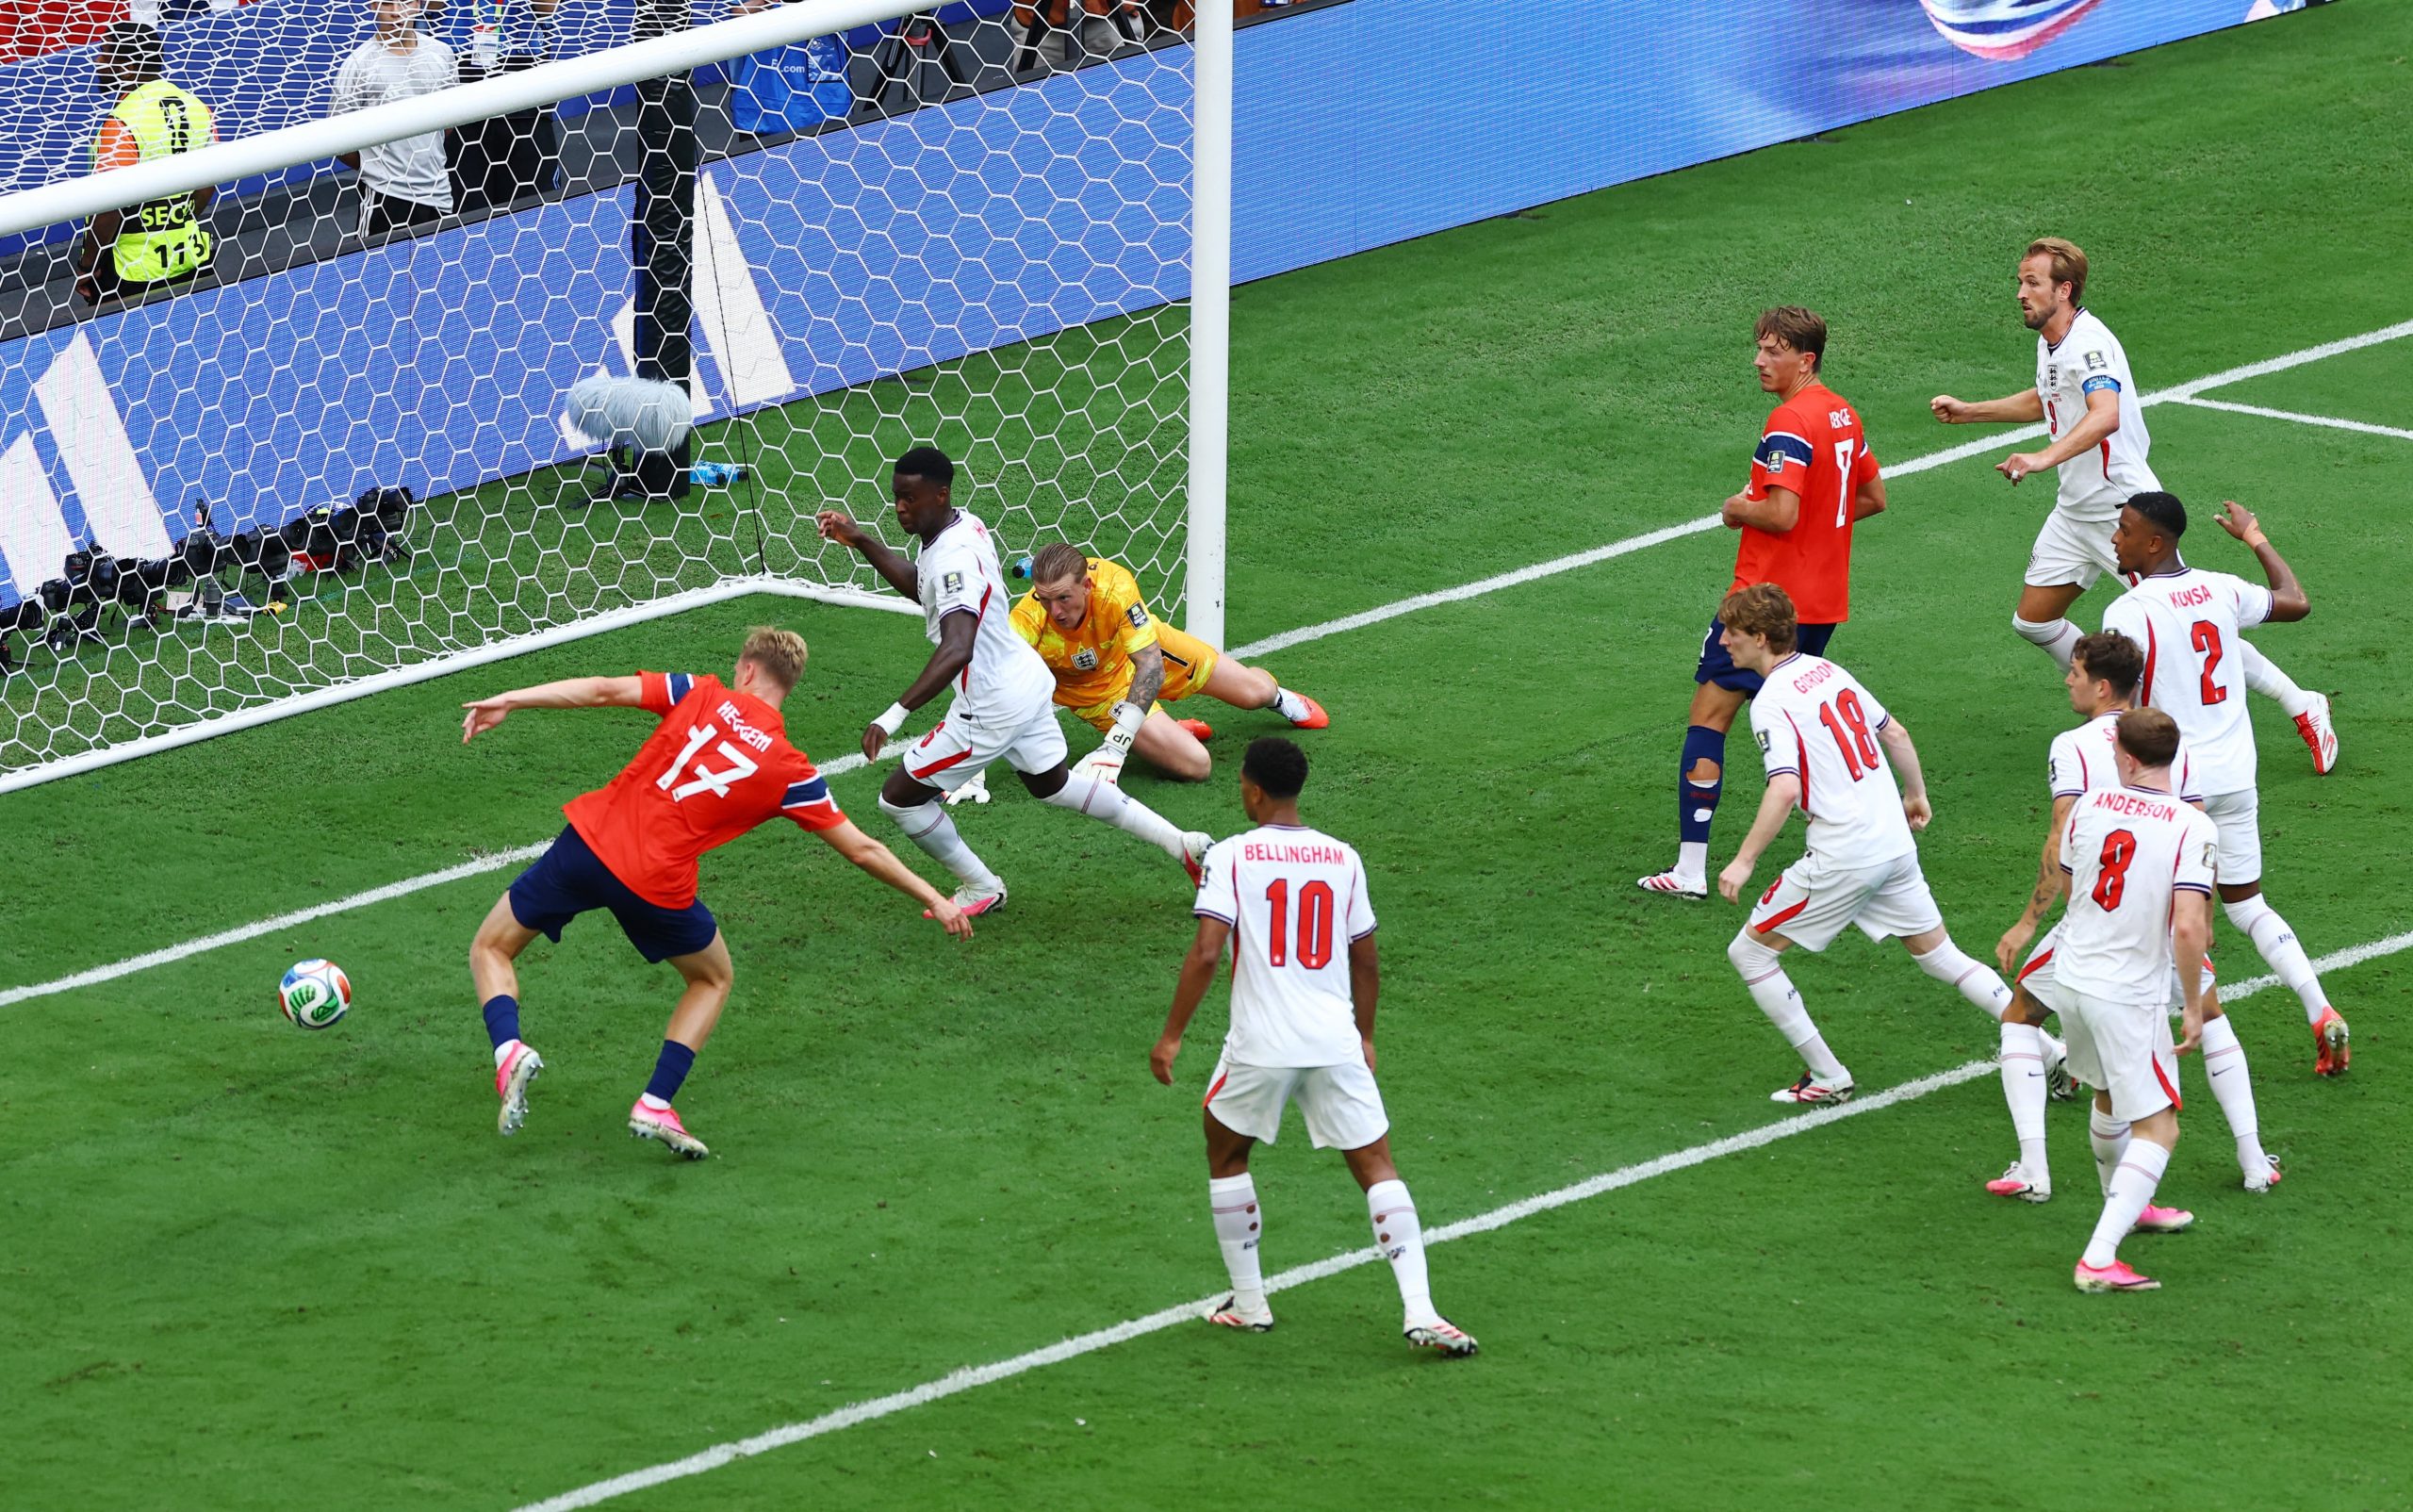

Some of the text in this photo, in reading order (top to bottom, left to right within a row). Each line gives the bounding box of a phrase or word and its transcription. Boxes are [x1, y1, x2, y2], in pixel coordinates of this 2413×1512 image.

[154, 233, 205, 269] 113
[2047, 400, 2058, 436] 9
[1793, 662, 1834, 695] GORDON
[2191, 618, 2226, 706] 2
[655, 722, 760, 803] 17
[1819, 687, 1880, 783] 18
[2093, 793, 2177, 823] ANDERSON
[1244, 844, 1345, 866] BELLINGHAM
[2092, 829, 2137, 912] 8
[1265, 878, 1334, 970] 10
